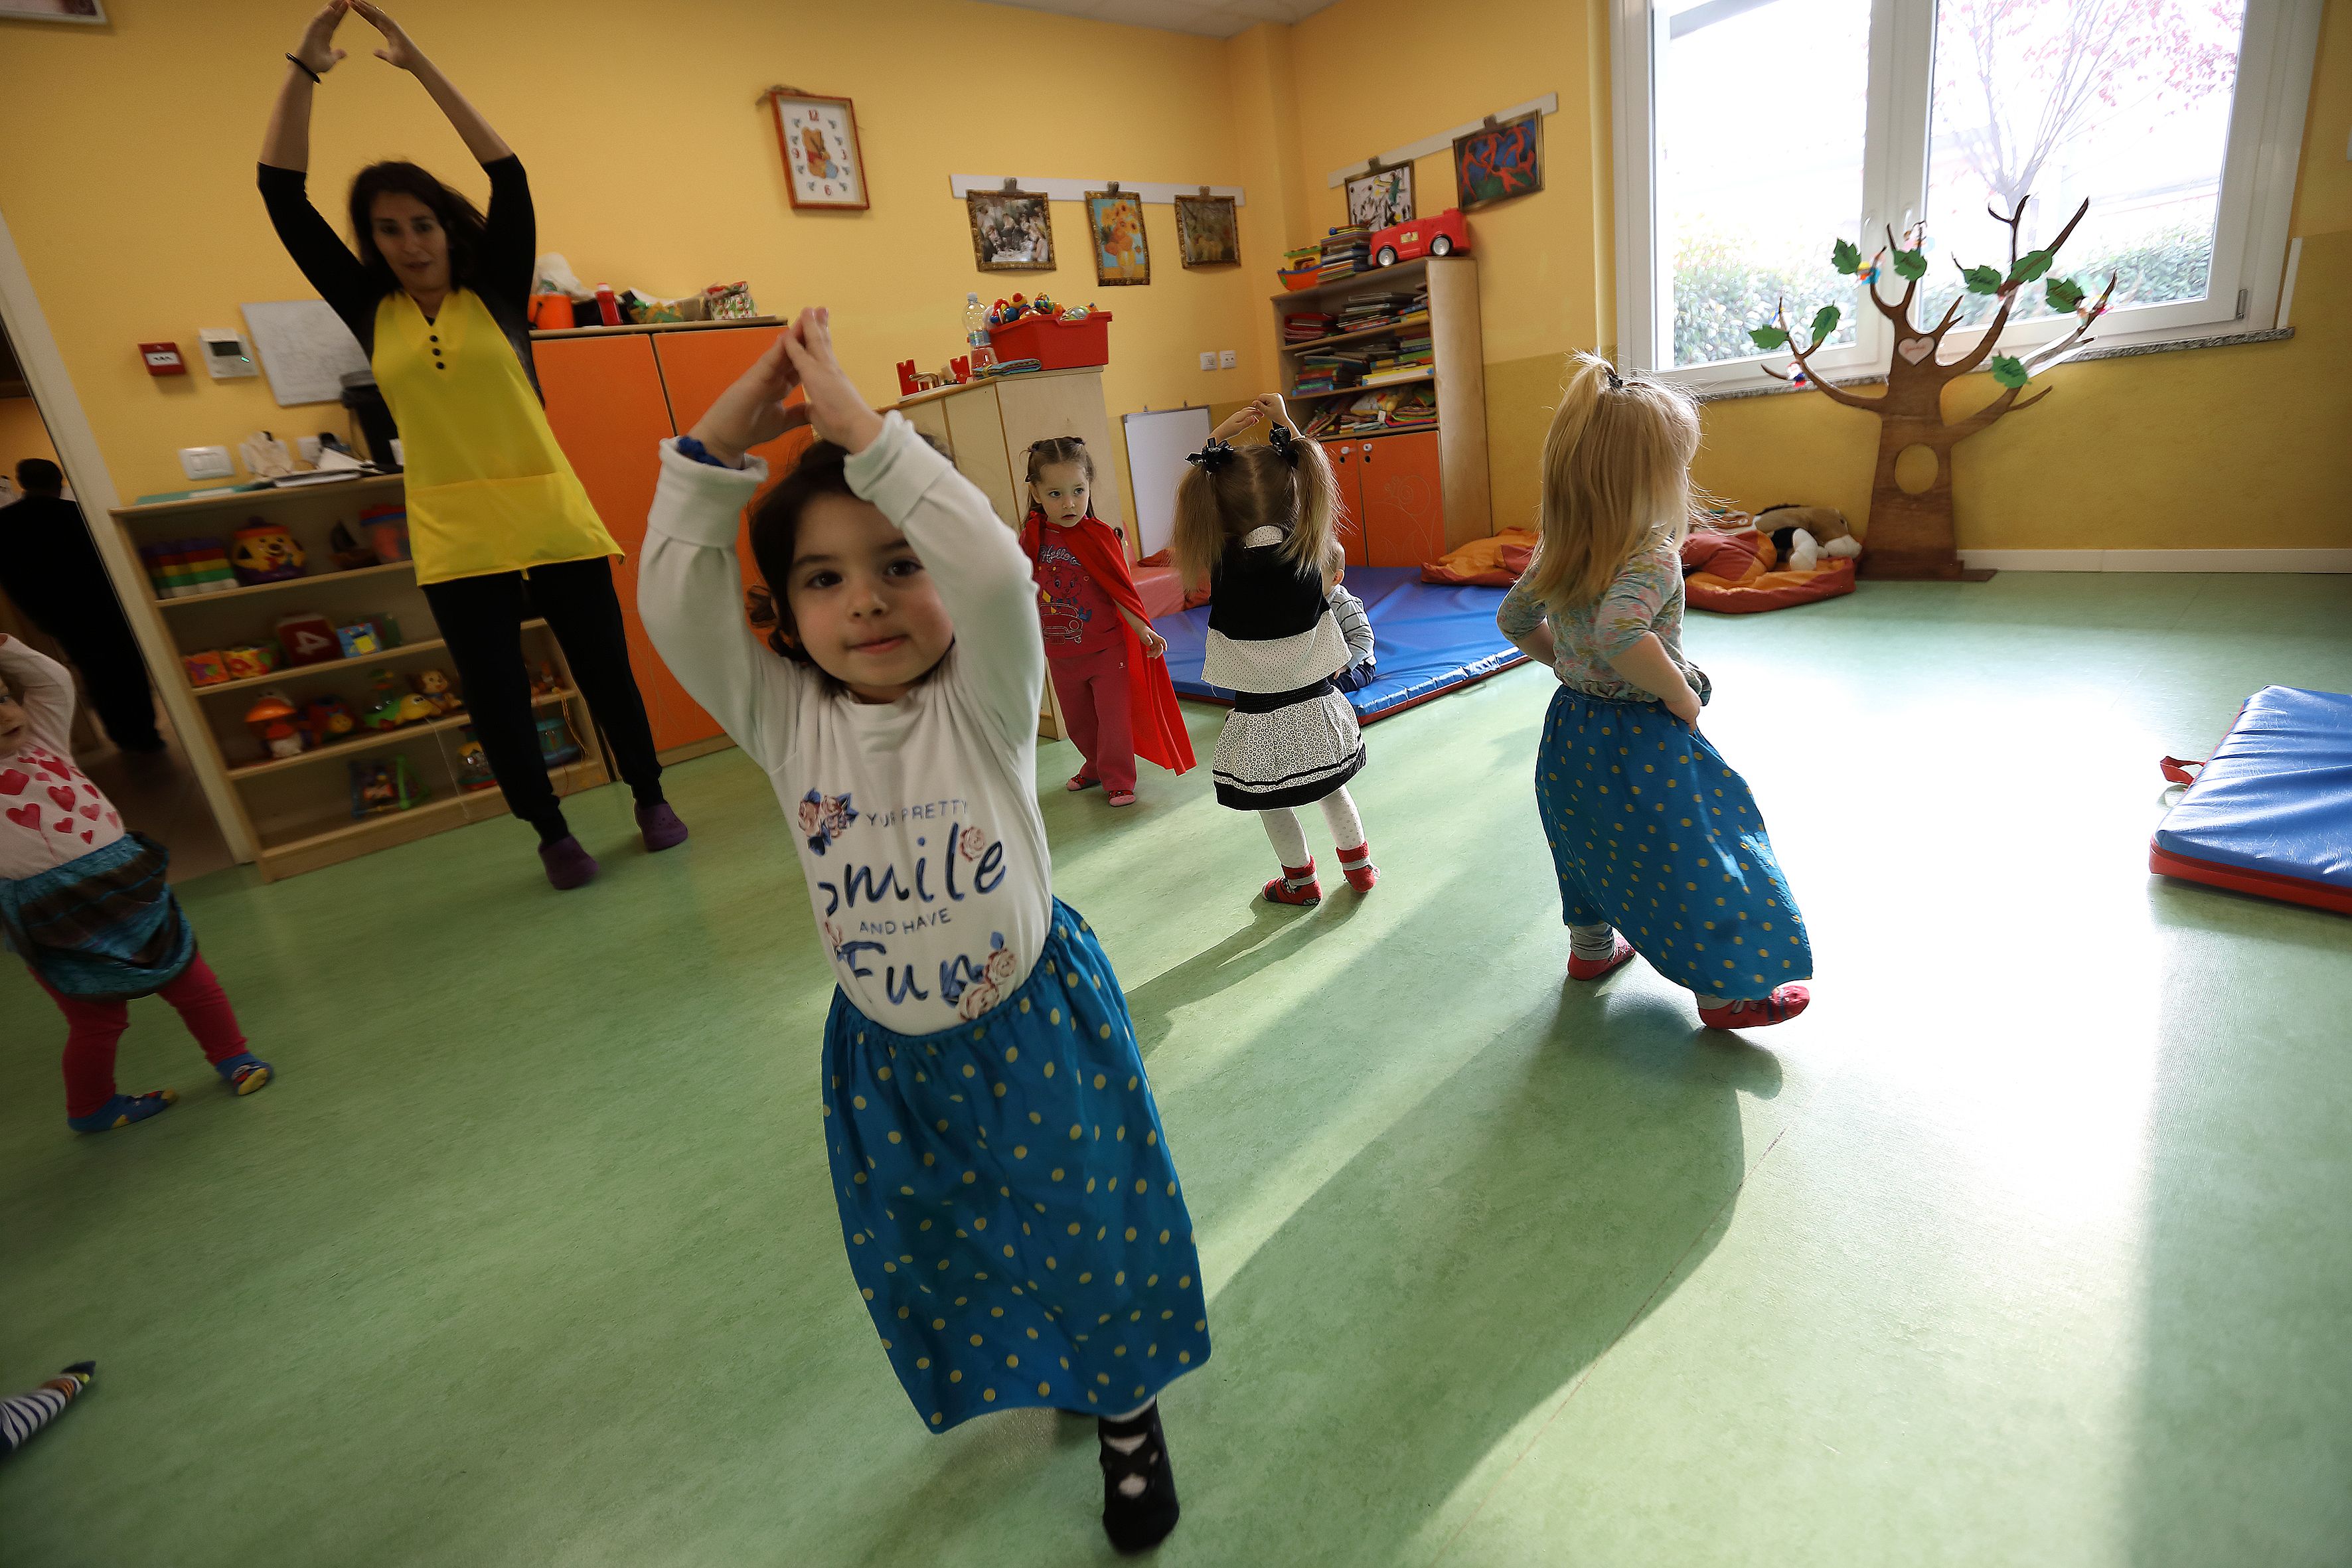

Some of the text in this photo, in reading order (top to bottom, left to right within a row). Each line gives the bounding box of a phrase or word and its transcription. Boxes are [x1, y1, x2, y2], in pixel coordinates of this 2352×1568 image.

[808, 109, 819, 122] 12
[792, 147, 848, 160] 9 3
[823, 184, 832, 196] 6
[1040, 544, 1071, 564] Hello
[901, 799, 967, 823] PRETTY
[859, 907, 951, 935] AND HAVE
